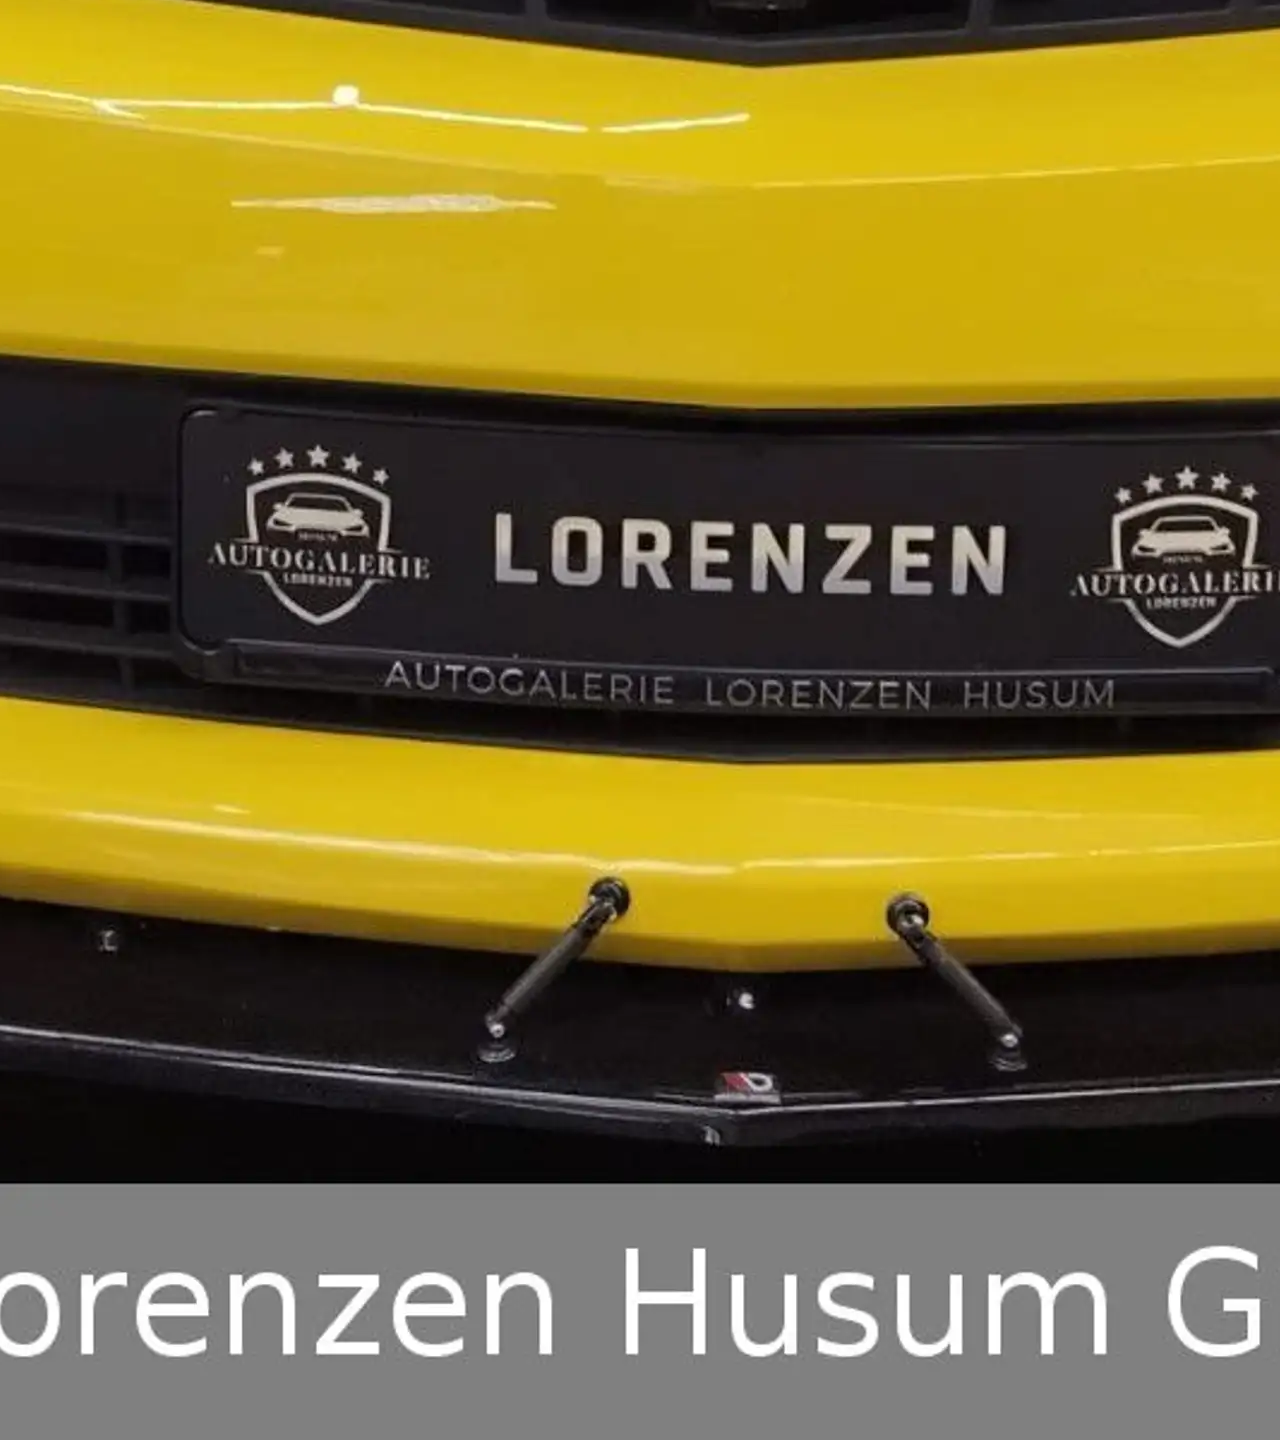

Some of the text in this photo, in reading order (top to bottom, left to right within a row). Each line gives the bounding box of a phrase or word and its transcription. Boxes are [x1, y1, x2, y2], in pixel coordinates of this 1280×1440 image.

[208, 542, 431, 580] AUTOGALERIE
[494, 512, 1007, 596] LORENZEN
[384, 661, 1116, 709] AUTOGALERIE LORENZEN HUSUM
